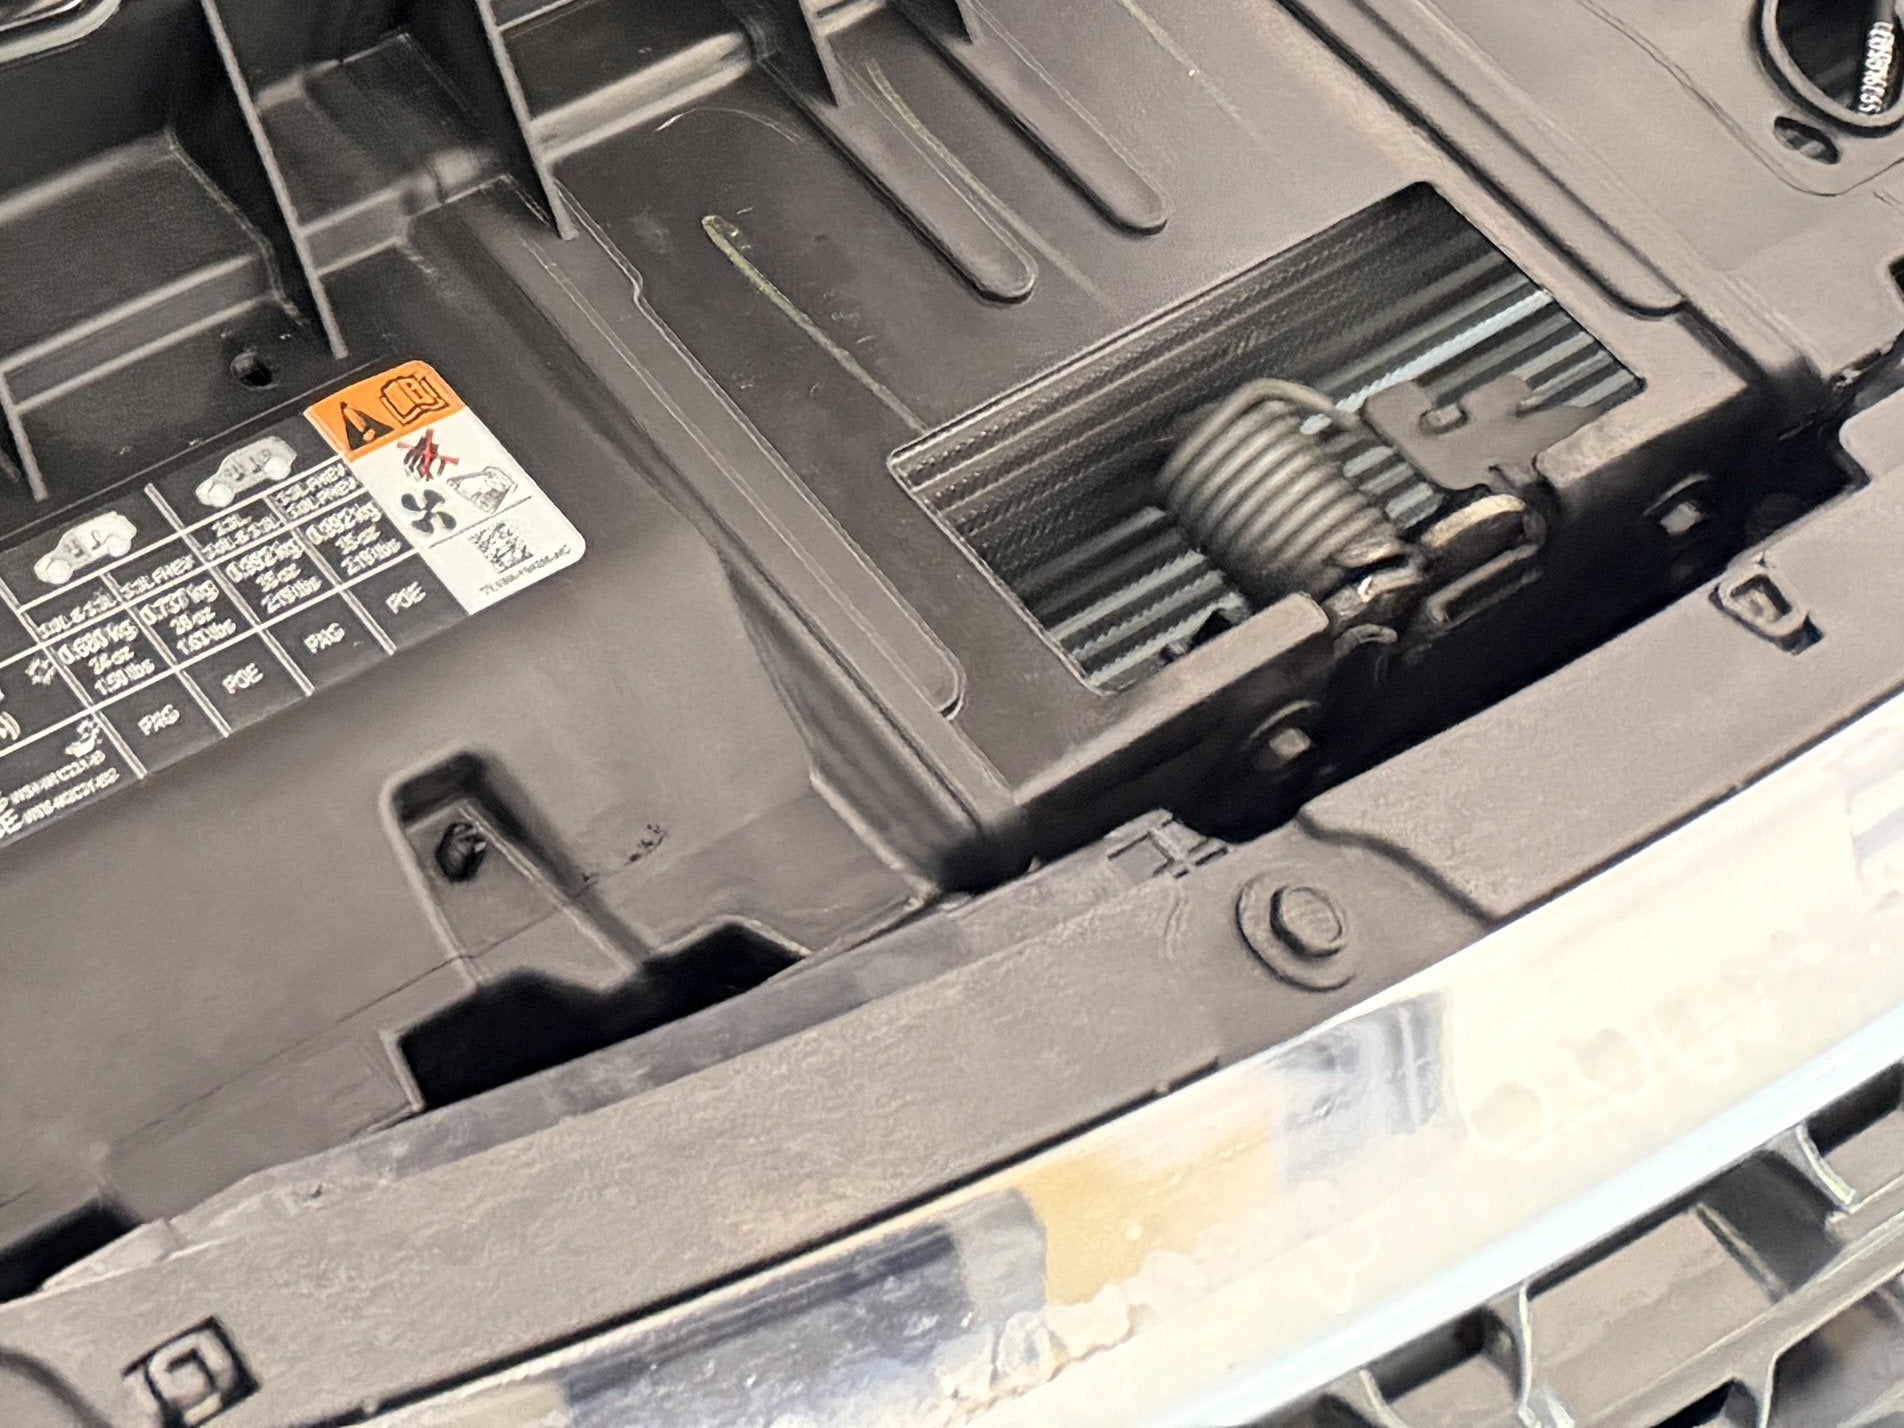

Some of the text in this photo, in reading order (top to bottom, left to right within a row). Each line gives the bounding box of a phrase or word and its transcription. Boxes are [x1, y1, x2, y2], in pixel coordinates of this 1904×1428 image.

[355, 524, 380, 545] oz
[276, 562, 301, 583] oz
[184, 578, 219, 603] kg
[385, 581, 426, 613] POE
[190, 605, 216, 625] oz
[103, 618, 138, 642] kg
[203, 618, 236, 641] lbs
[303, 622, 345, 653] PAG
[109, 644, 134, 665] oz
[123, 658, 155, 680] lbs
[221, 662, 263, 694] POE
[137, 704, 180, 735] PAG
